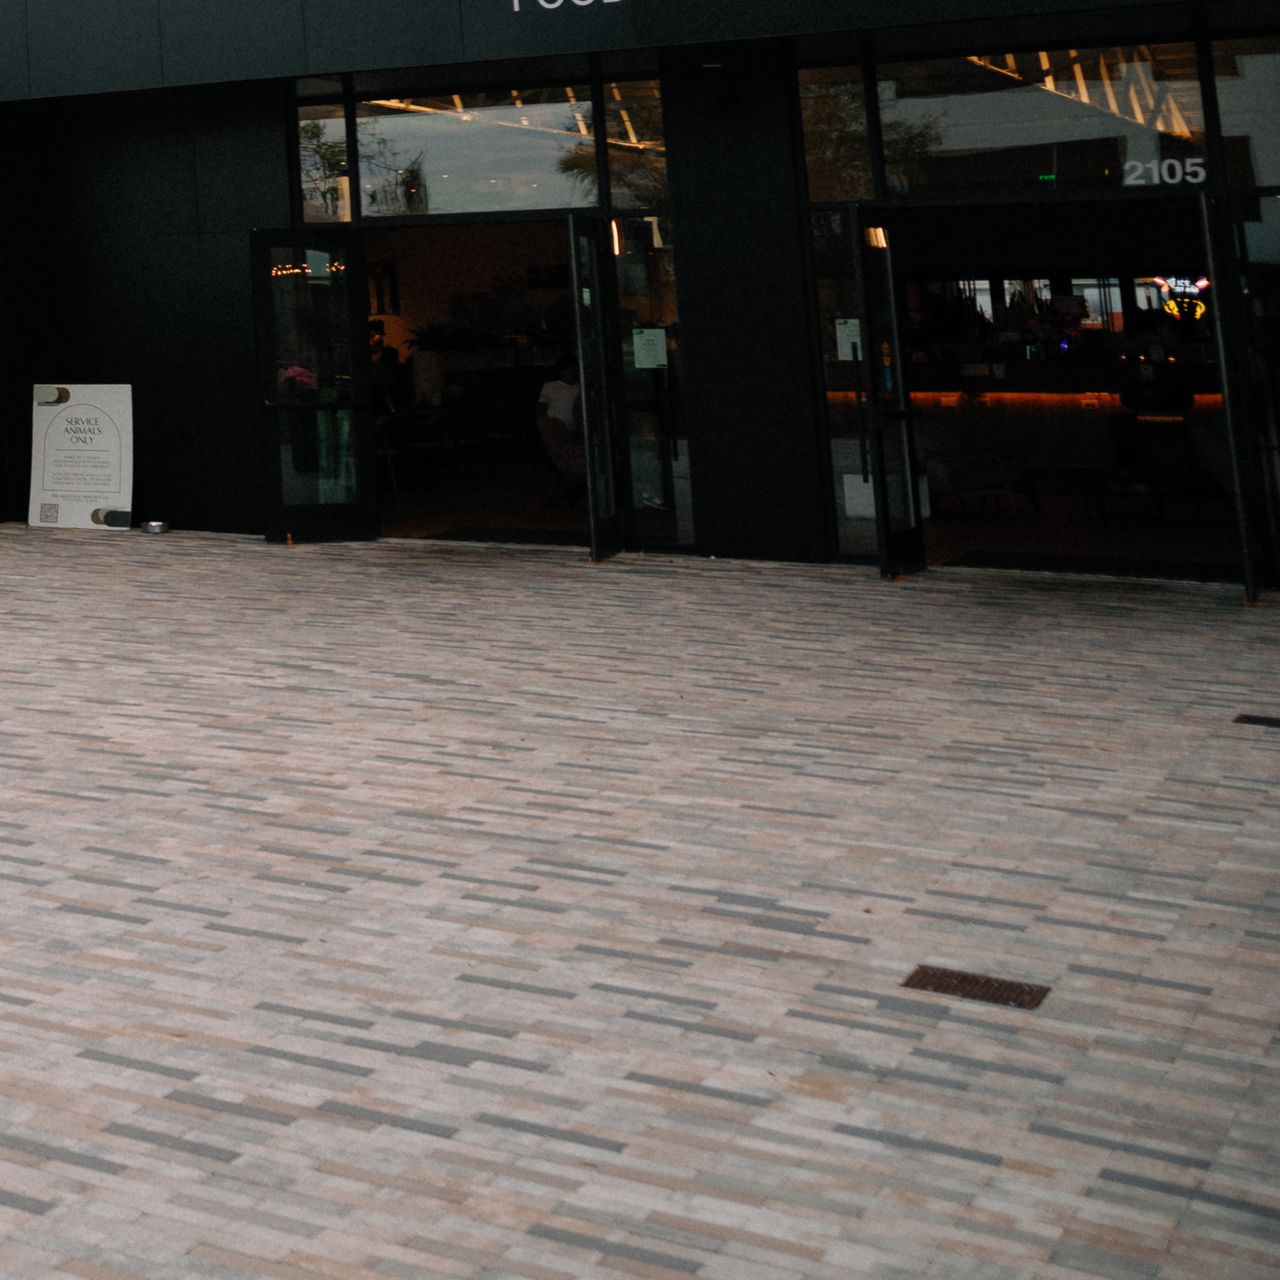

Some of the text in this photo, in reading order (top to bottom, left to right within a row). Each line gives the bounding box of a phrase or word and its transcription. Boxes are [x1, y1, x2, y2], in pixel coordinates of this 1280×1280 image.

[1122, 158, 1207, 185] 2105
[64, 417, 99, 426] SERVICE
[63, 426, 103, 435] ANIMALS
[70, 435, 95, 444] ONLY
